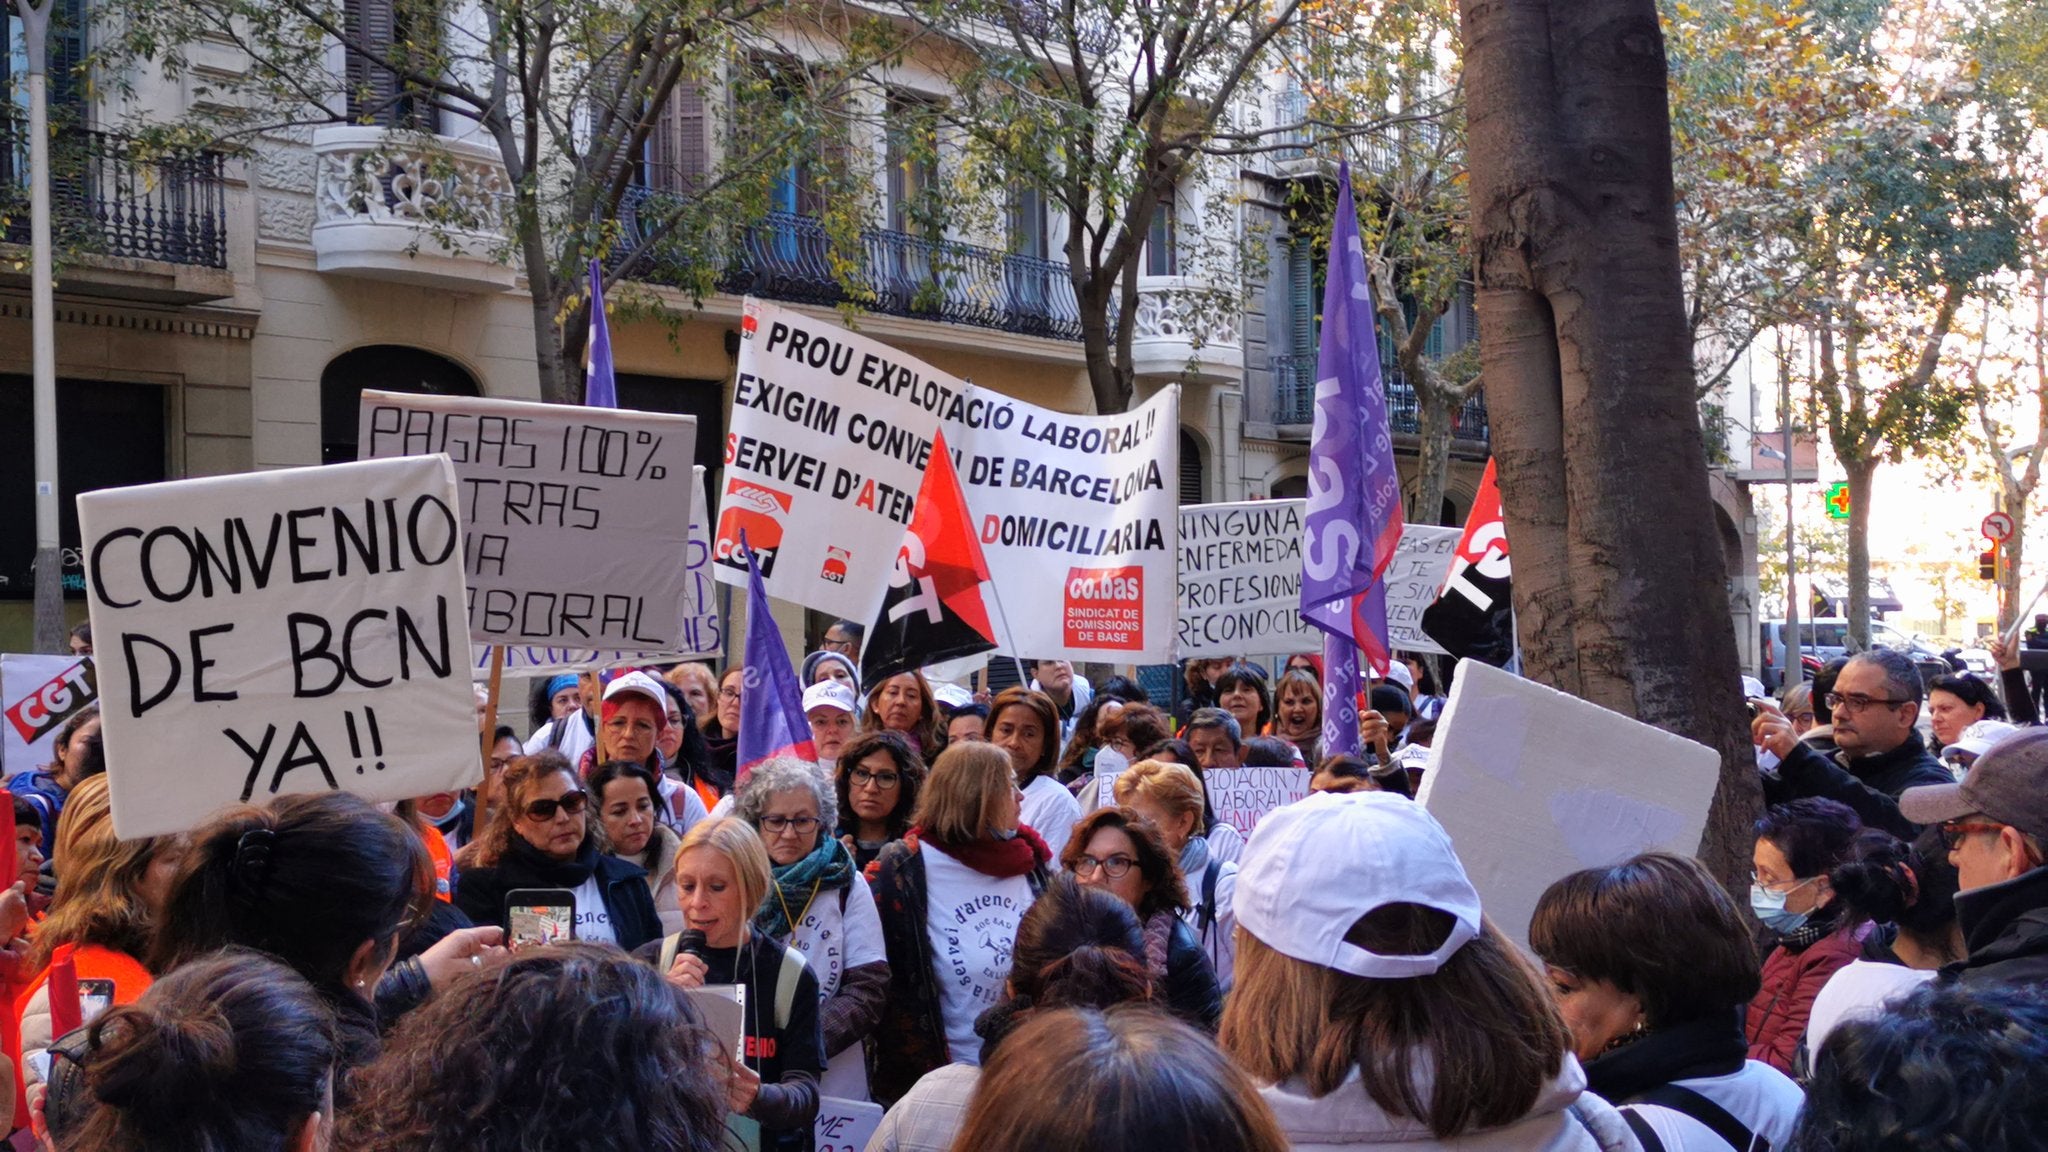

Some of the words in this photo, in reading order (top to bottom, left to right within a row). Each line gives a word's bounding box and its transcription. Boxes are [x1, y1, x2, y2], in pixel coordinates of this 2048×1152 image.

[766, 321, 854, 376] PROU
[857, 353, 1014, 430] EXPLOTACIÓ
[1021, 414, 1141, 454] LABORAL
[370, 406, 537, 469] PAGAS
[560, 425, 667, 481] 100%
[735, 372, 841, 436] EXIGIM
[848, 413, 962, 472] CONVEI
[968, 455, 1004, 488] DE
[1010, 459, 1163, 504] BARCELONA
[724, 432, 827, 492] SERVEI
[981, 514, 1165, 556] DOMICILIARIA
[1178, 506, 1300, 540] NINGUNA
[90, 493, 457, 609] CONVENIO
[716, 538, 773, 568] CGT
[1408, 561, 1433, 577] TE
[822, 570, 844, 583] CGT
[1066, 619, 1140, 631] COMISSIONS
[1067, 607, 1120, 618] SINDICAT
[1123, 609, 1139, 619] DE
[1178, 608, 1322, 647] RECONOCID
[122, 623, 239, 718] DE
[287, 595, 452, 698] BCN
[1078, 631, 1094, 641] DE
[1097, 632, 1129, 643] BASE
[20, 663, 92, 728] CGT
[1291, 770, 1301, 789] Y
[944, 927, 972, 986] servei
